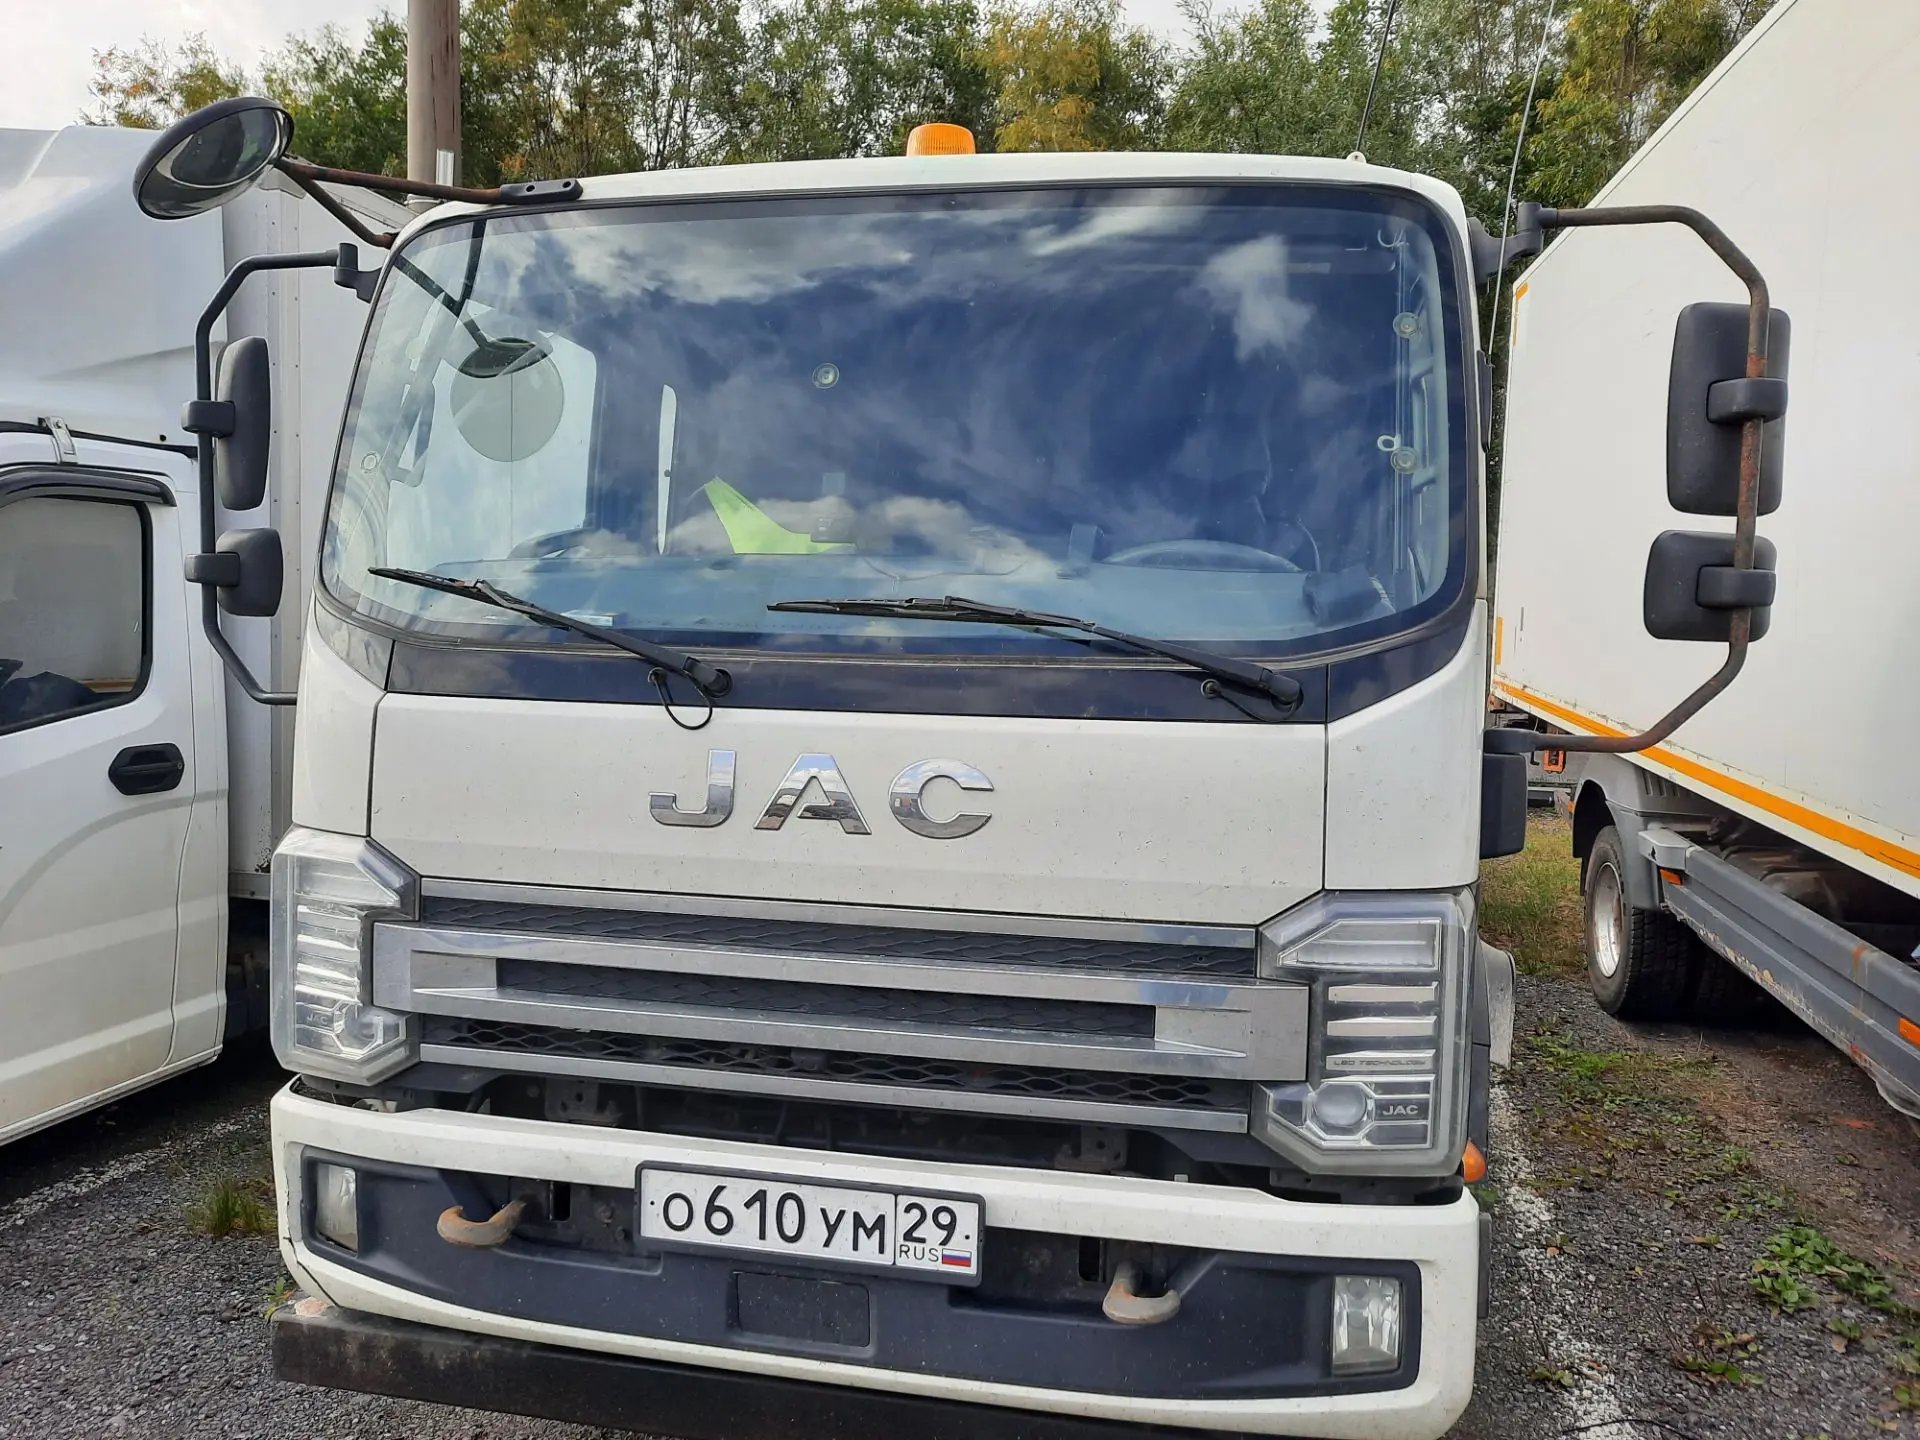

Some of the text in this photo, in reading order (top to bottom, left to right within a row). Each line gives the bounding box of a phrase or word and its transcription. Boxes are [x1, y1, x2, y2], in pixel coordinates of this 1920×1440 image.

[649, 749, 995, 840] JAC
[1382, 1104, 1419, 1116] JAC
[902, 1202, 958, 1246] 29
[899, 1244, 940, 1263] RUS
